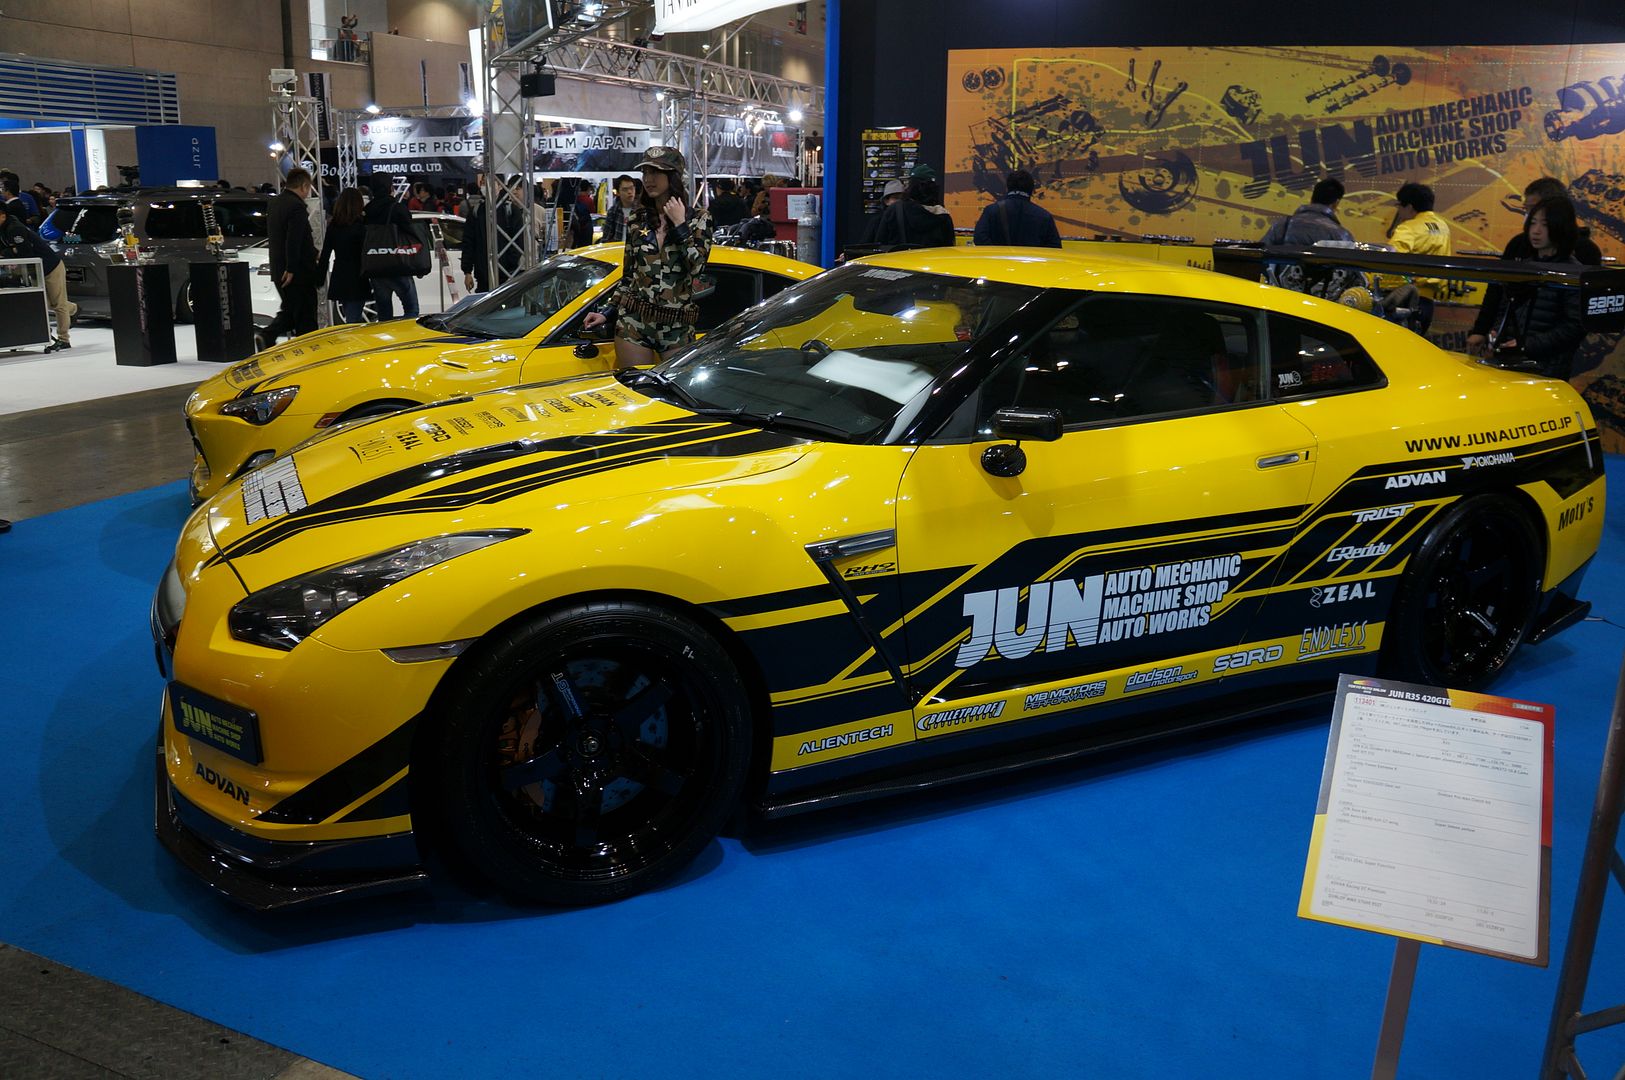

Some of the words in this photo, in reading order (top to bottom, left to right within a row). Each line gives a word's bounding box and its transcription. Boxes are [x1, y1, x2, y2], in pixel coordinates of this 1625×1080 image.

[1376, 110, 1425, 135] AUTO
[1429, 86, 1533, 125] MECHANIC
[538, 138, 577, 150] FILM
[583, 136, 637, 149] JAPAN
[1379, 122, 1467, 155] MACHINE
[1469, 110, 1522, 136] SHOP
[191, 137, 201, 169] azur
[379, 141, 427, 154] SUPER
[433, 140, 483, 153] PROTE
[1240, 119, 1378, 199] JUN
[1381, 149, 1430, 175] AUTO
[1434, 133, 1507, 164] WORKS
[373, 164, 407, 173] SAKURAI
[367, 247, 417, 255] ADVAN
[1587, 307, 1608, 315] RACING
[1608, 306, 1624, 314] TEAM
[1405, 416, 1572, 453] WWW.JUNAUTO.CO.JP
[1473, 452, 1516, 468] YOKOHAMA
[1385, 471, 1446, 490] ADVAN
[1352, 503, 1414, 523] TRUST
[1558, 496, 1594, 531] Moty's
[1327, 541, 1392, 562] GReddy
[1105, 564, 1151, 597] AUTO
[1154, 554, 1242, 590] MECHANIC
[1102, 589, 1181, 621] MACHINE
[1184, 580, 1229, 607] SHOP
[1322, 581, 1376, 605] ZEAL
[954, 573, 1105, 668] JUN
[1099, 615, 1146, 644] AUTO
[1148, 605, 1211, 635] WORKS
[1299, 620, 1368, 654] ENDLESS
[1213, 644, 1284, 673] SARD
[1127, 665, 1183, 687] dodson
[1150, 670, 1198, 688] motorsport
[1024, 688, 1106, 712] PERFORMANCE
[1025, 694, 1048, 704] MB
[1049, 680, 1107, 701] MOTORS
[1388, 689, 1404, 699] JUN
[1405, 692, 1420, 701] R35
[1421, 695, 1452, 706] 420GTR
[180, 701, 213, 737] JUN
[928, 702, 998, 725] BULLETPROOF
[798, 724, 894, 755] ALIENTECH
[195, 762, 250, 806] ADVAN
